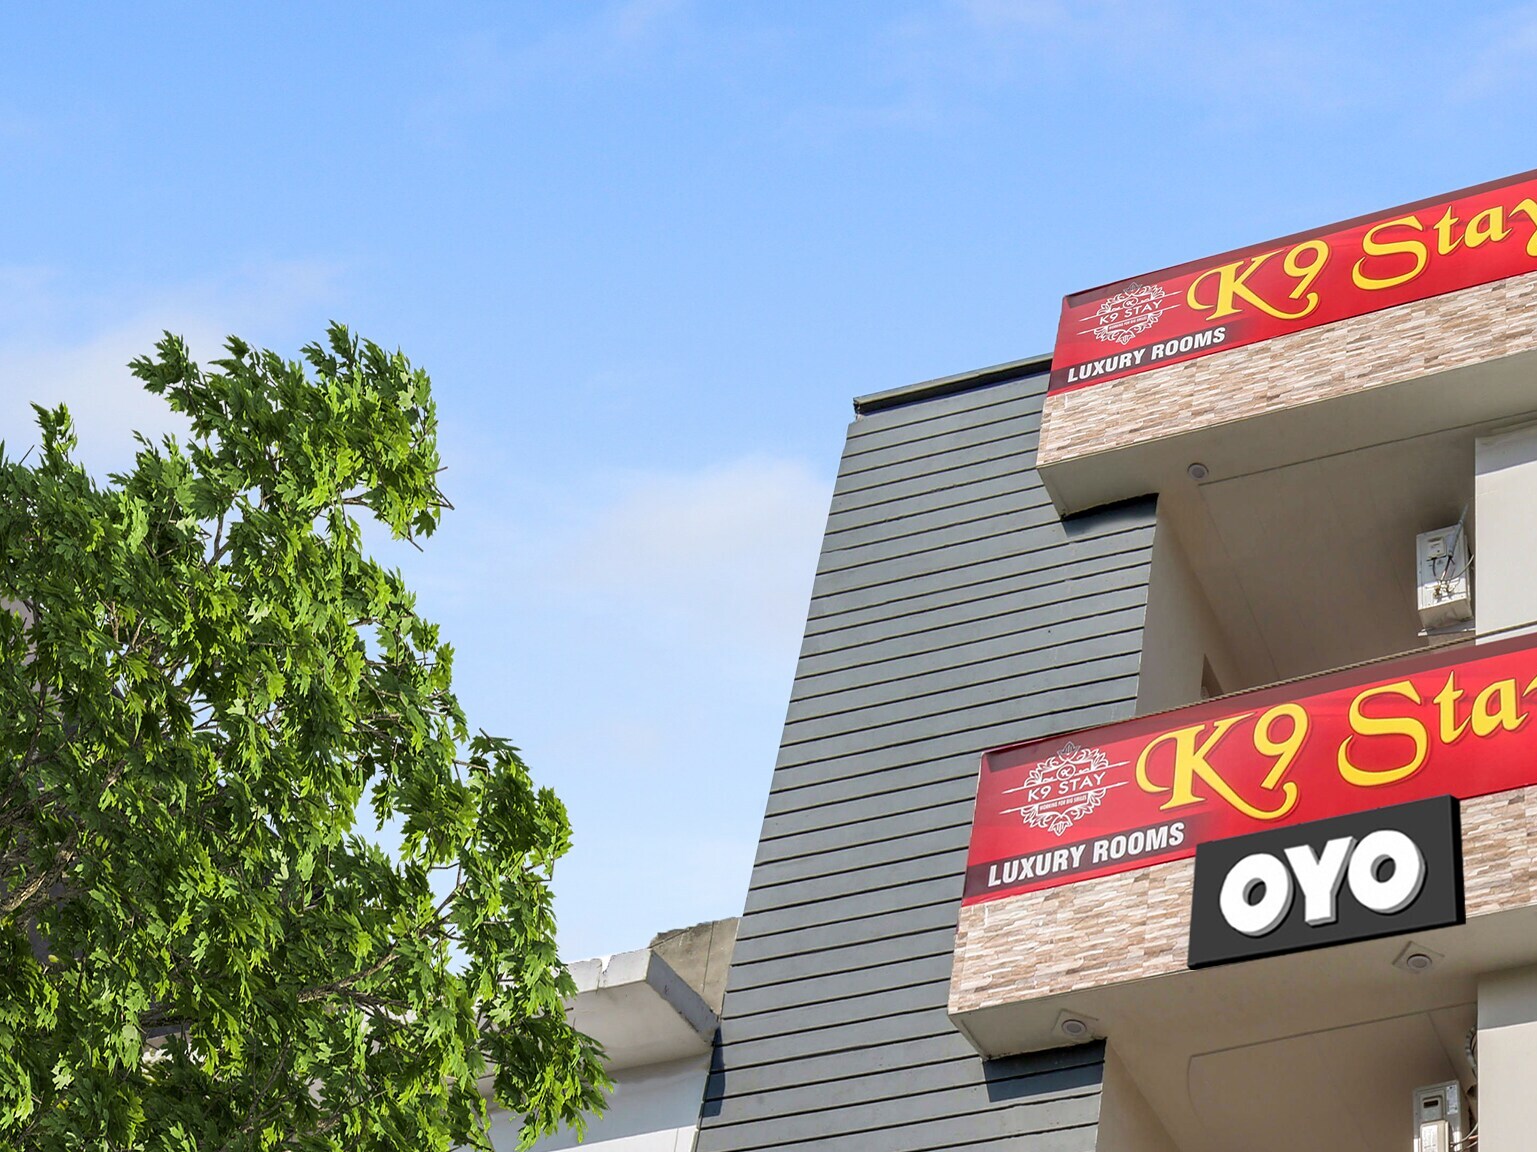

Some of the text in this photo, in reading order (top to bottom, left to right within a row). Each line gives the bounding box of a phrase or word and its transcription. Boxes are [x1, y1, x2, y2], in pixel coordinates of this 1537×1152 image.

[1099, 312, 1119, 325] K9
[1124, 299, 1163, 318] STAY
[1186, 239, 1330, 319] K9
[1067, 326, 1227, 383] LUXURY ROOMS
[1027, 771, 1107, 802] K9 STAY
[1134, 702, 1309, 820] K9
[987, 821, 1186, 888] LUXURY ROOMS
[1219, 829, 1427, 938] OYO
